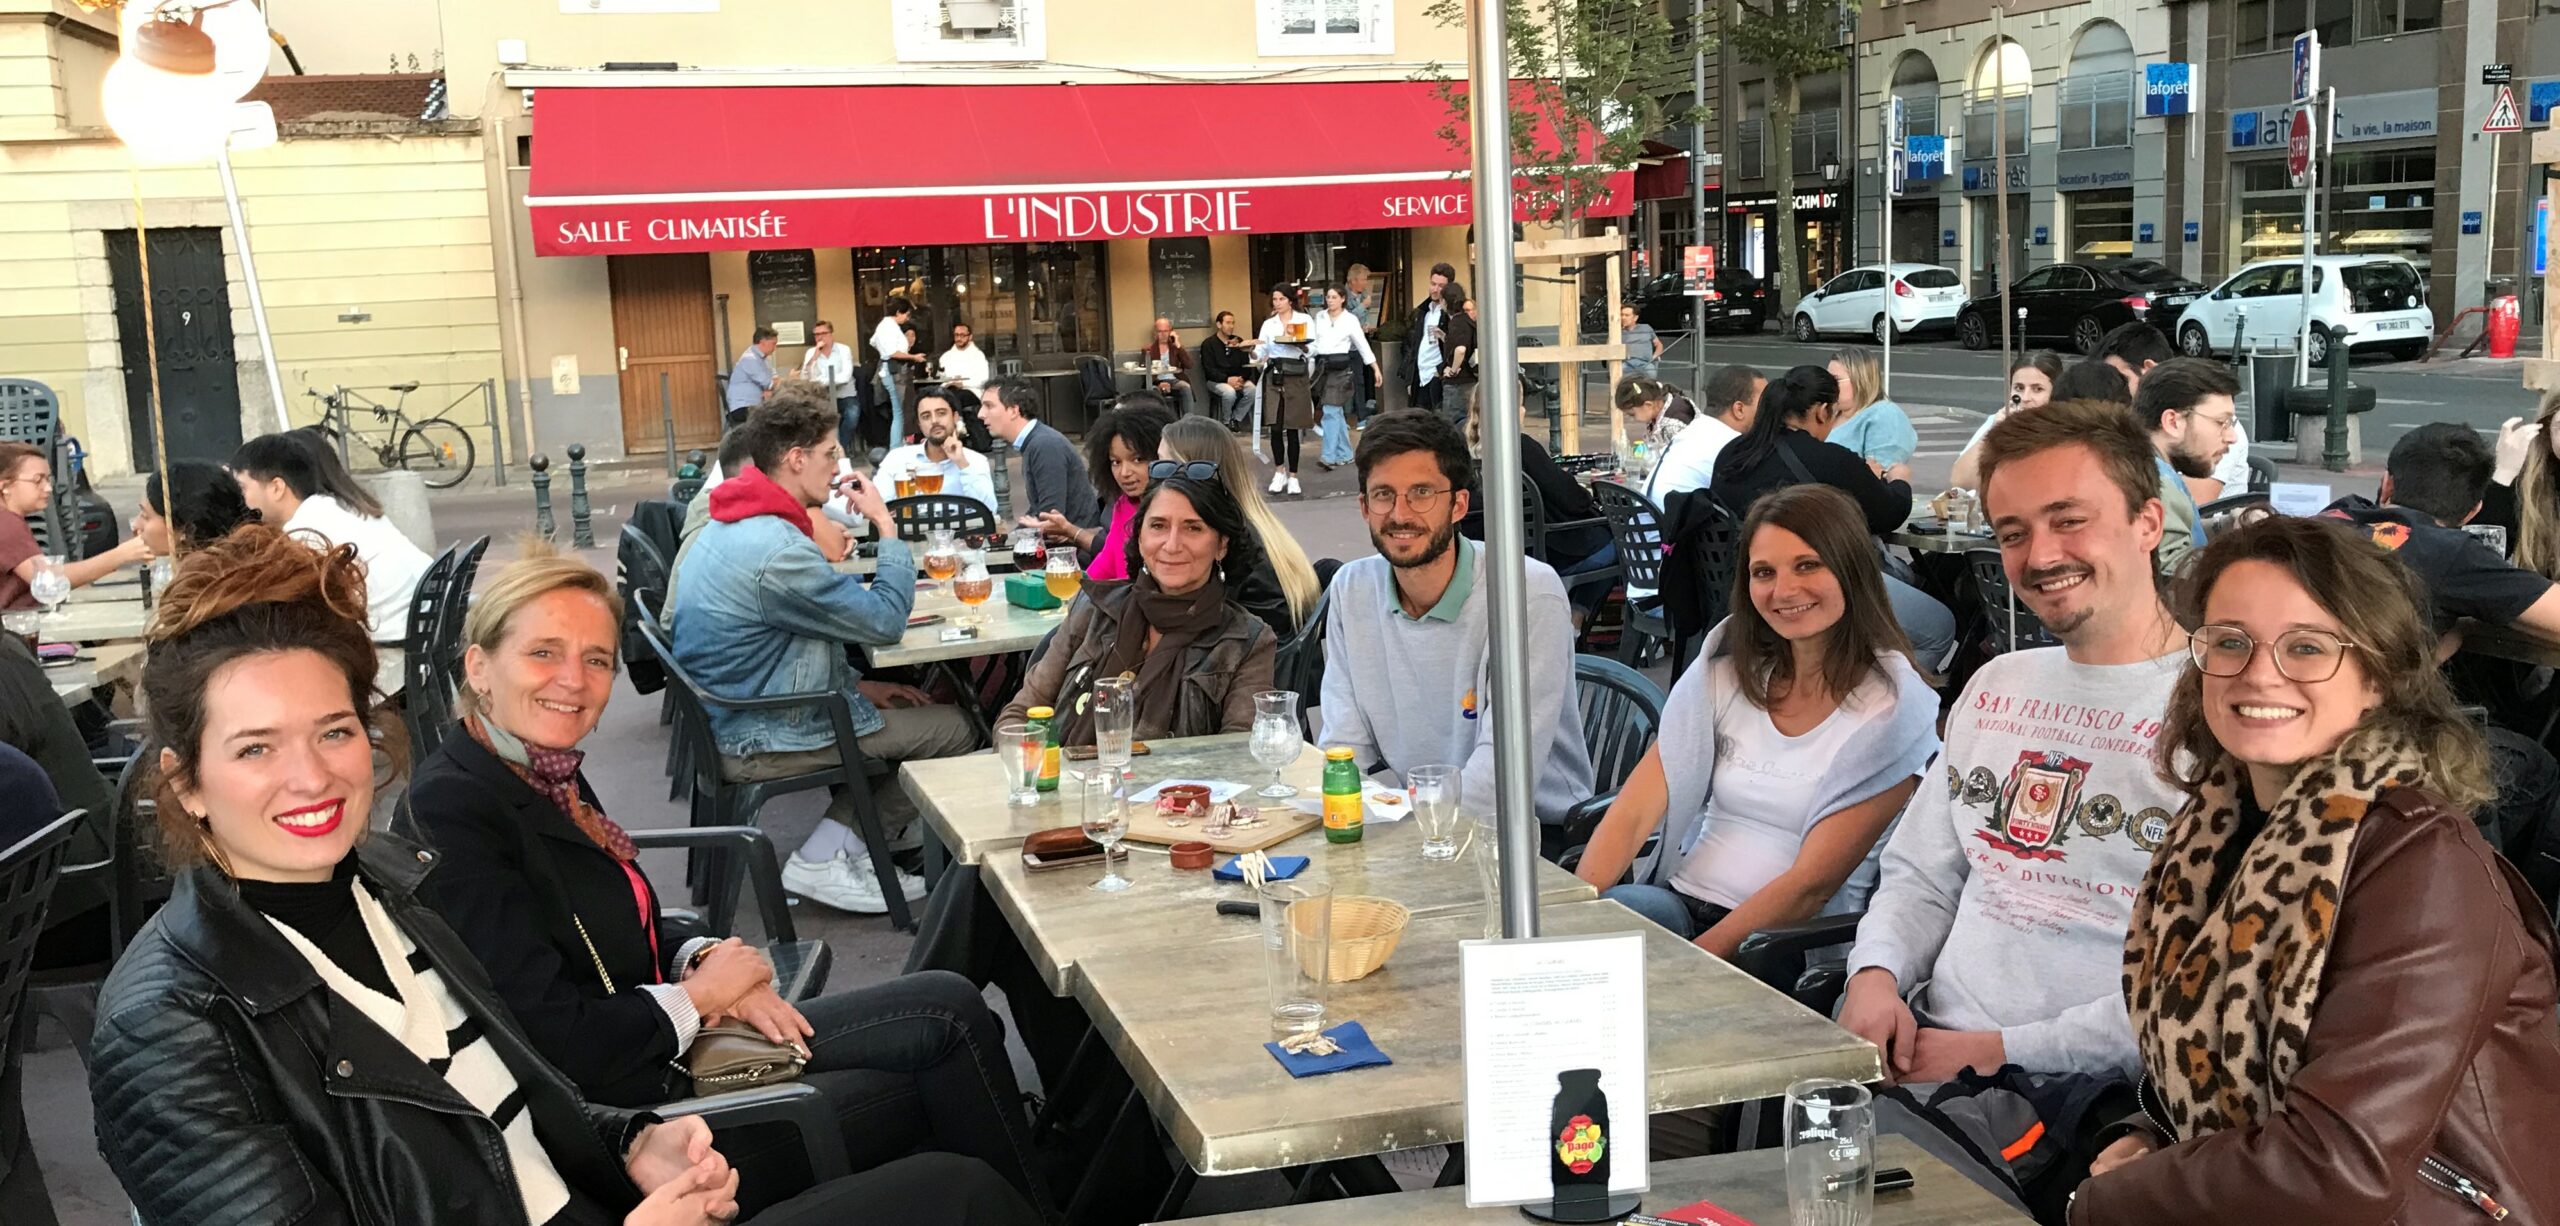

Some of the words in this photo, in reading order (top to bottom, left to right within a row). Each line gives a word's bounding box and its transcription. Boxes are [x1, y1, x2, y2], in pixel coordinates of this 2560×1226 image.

[2147, 82, 2188, 95] laforêt
[2259, 108, 2344, 145] laft
[2352, 124, 2361, 136] la
[2362, 122, 2380, 136] vie,
[2383, 121, 2392, 134] la
[2394, 119, 2431, 132] maison
[1908, 149, 1944, 163] laforêt
[2290, 135, 2309, 158] STOP
[1980, 164, 2028, 188] lafrêt
[2058, 172, 2090, 185] location
[2091, 172, 2098, 184] &
[2099, 171, 2131, 186] gestion
[1382, 194, 1468, 217] SERVICE
[1792, 189, 1838, 209] SCHMIDT
[557, 220, 632, 244] SALLE
[647, 209, 788, 241] CLIMATISÉE
[984, 191, 1252, 239] L'INDUSTRIE
[182, 311, 191, 326] 9
[1974, 691, 2016, 714] SAN
[2018, 698, 2125, 731] FRANCISCO
[1974, 718, 2028, 737] NATIONAL
[2030, 726, 2086, 747] FOOTBALL
[2020, 869, 2137, 899] DIVISION
[1567, 1142, 1595, 1154] pago
